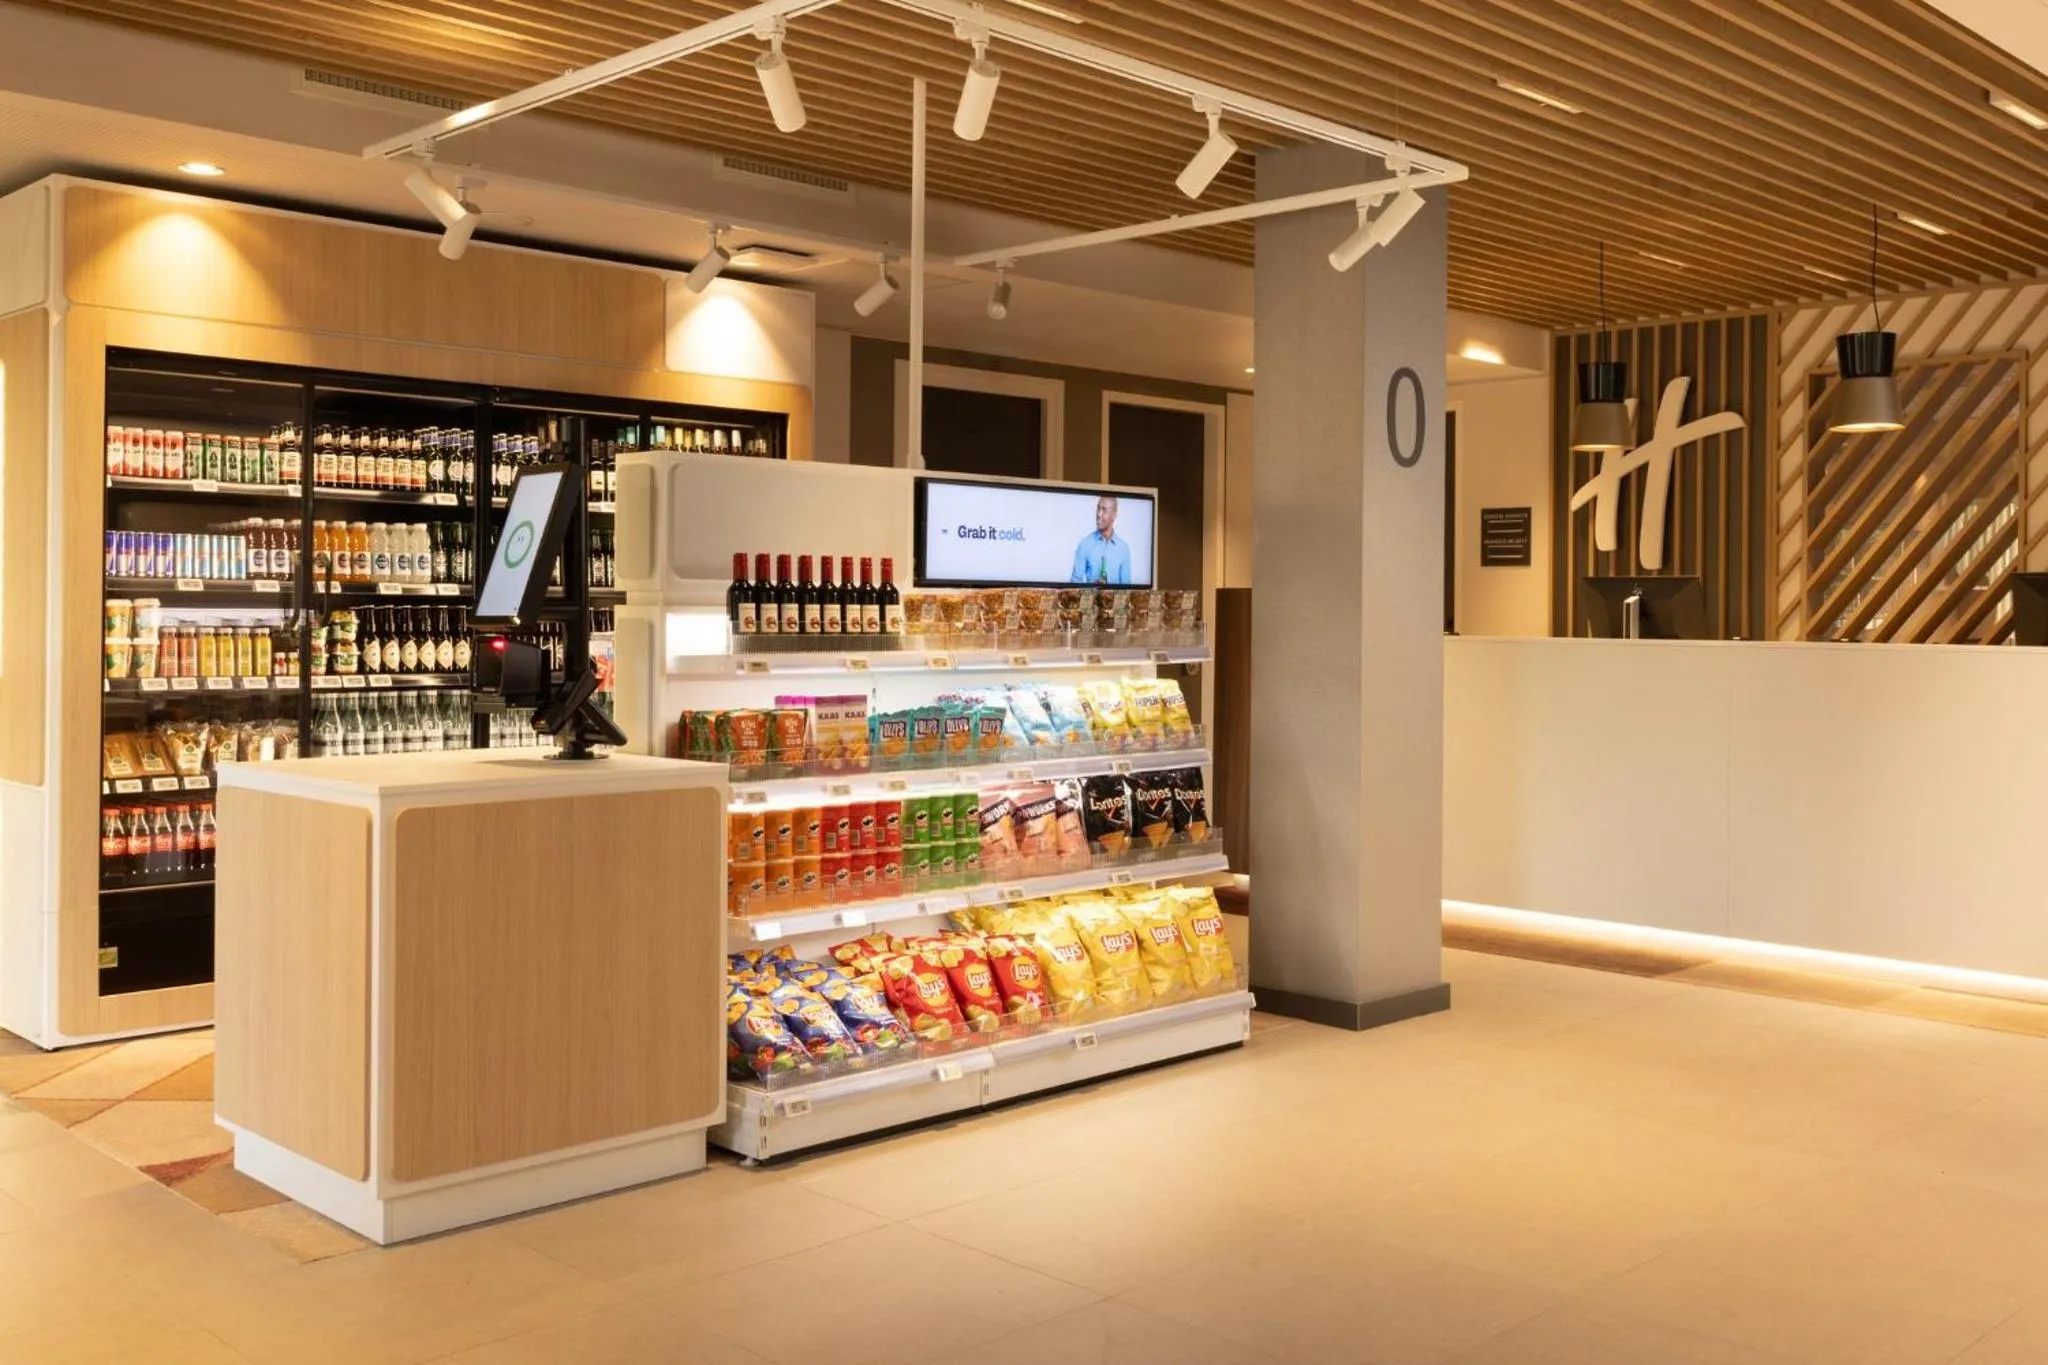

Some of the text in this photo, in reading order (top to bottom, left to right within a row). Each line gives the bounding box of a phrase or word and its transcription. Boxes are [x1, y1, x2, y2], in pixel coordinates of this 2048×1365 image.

[957, 524, 1026, 542] Grab it cold.
[818, 711, 839, 720] KAAS
[844, 710, 866, 719] KAAS
